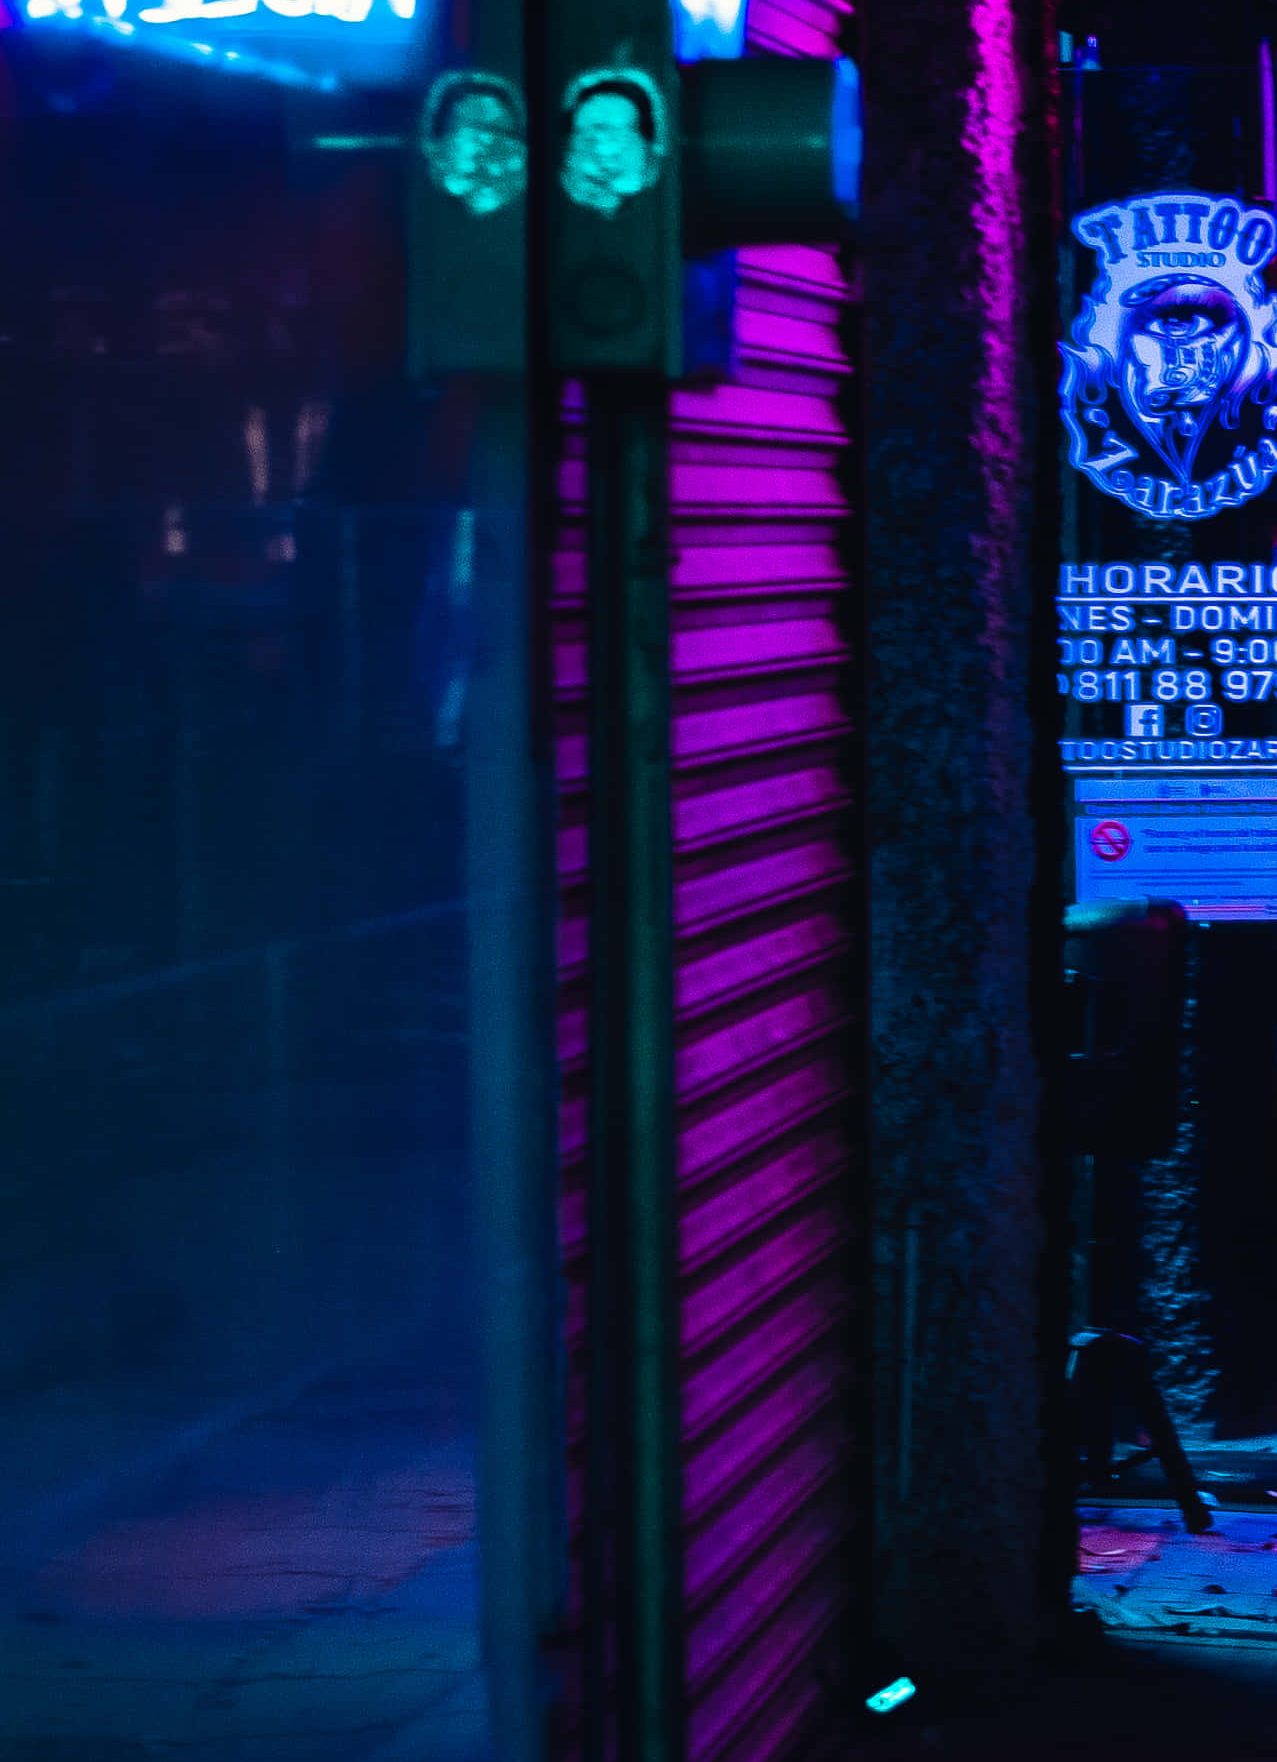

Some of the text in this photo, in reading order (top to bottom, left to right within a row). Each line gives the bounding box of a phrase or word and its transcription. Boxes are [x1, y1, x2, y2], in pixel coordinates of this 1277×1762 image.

[1081, 201, 1275, 267] TATTOO
[1136, 251, 1227, 268] STUDIO
[1110, 638, 1176, 665] AM
[1152, 669, 1211, 701] 88
